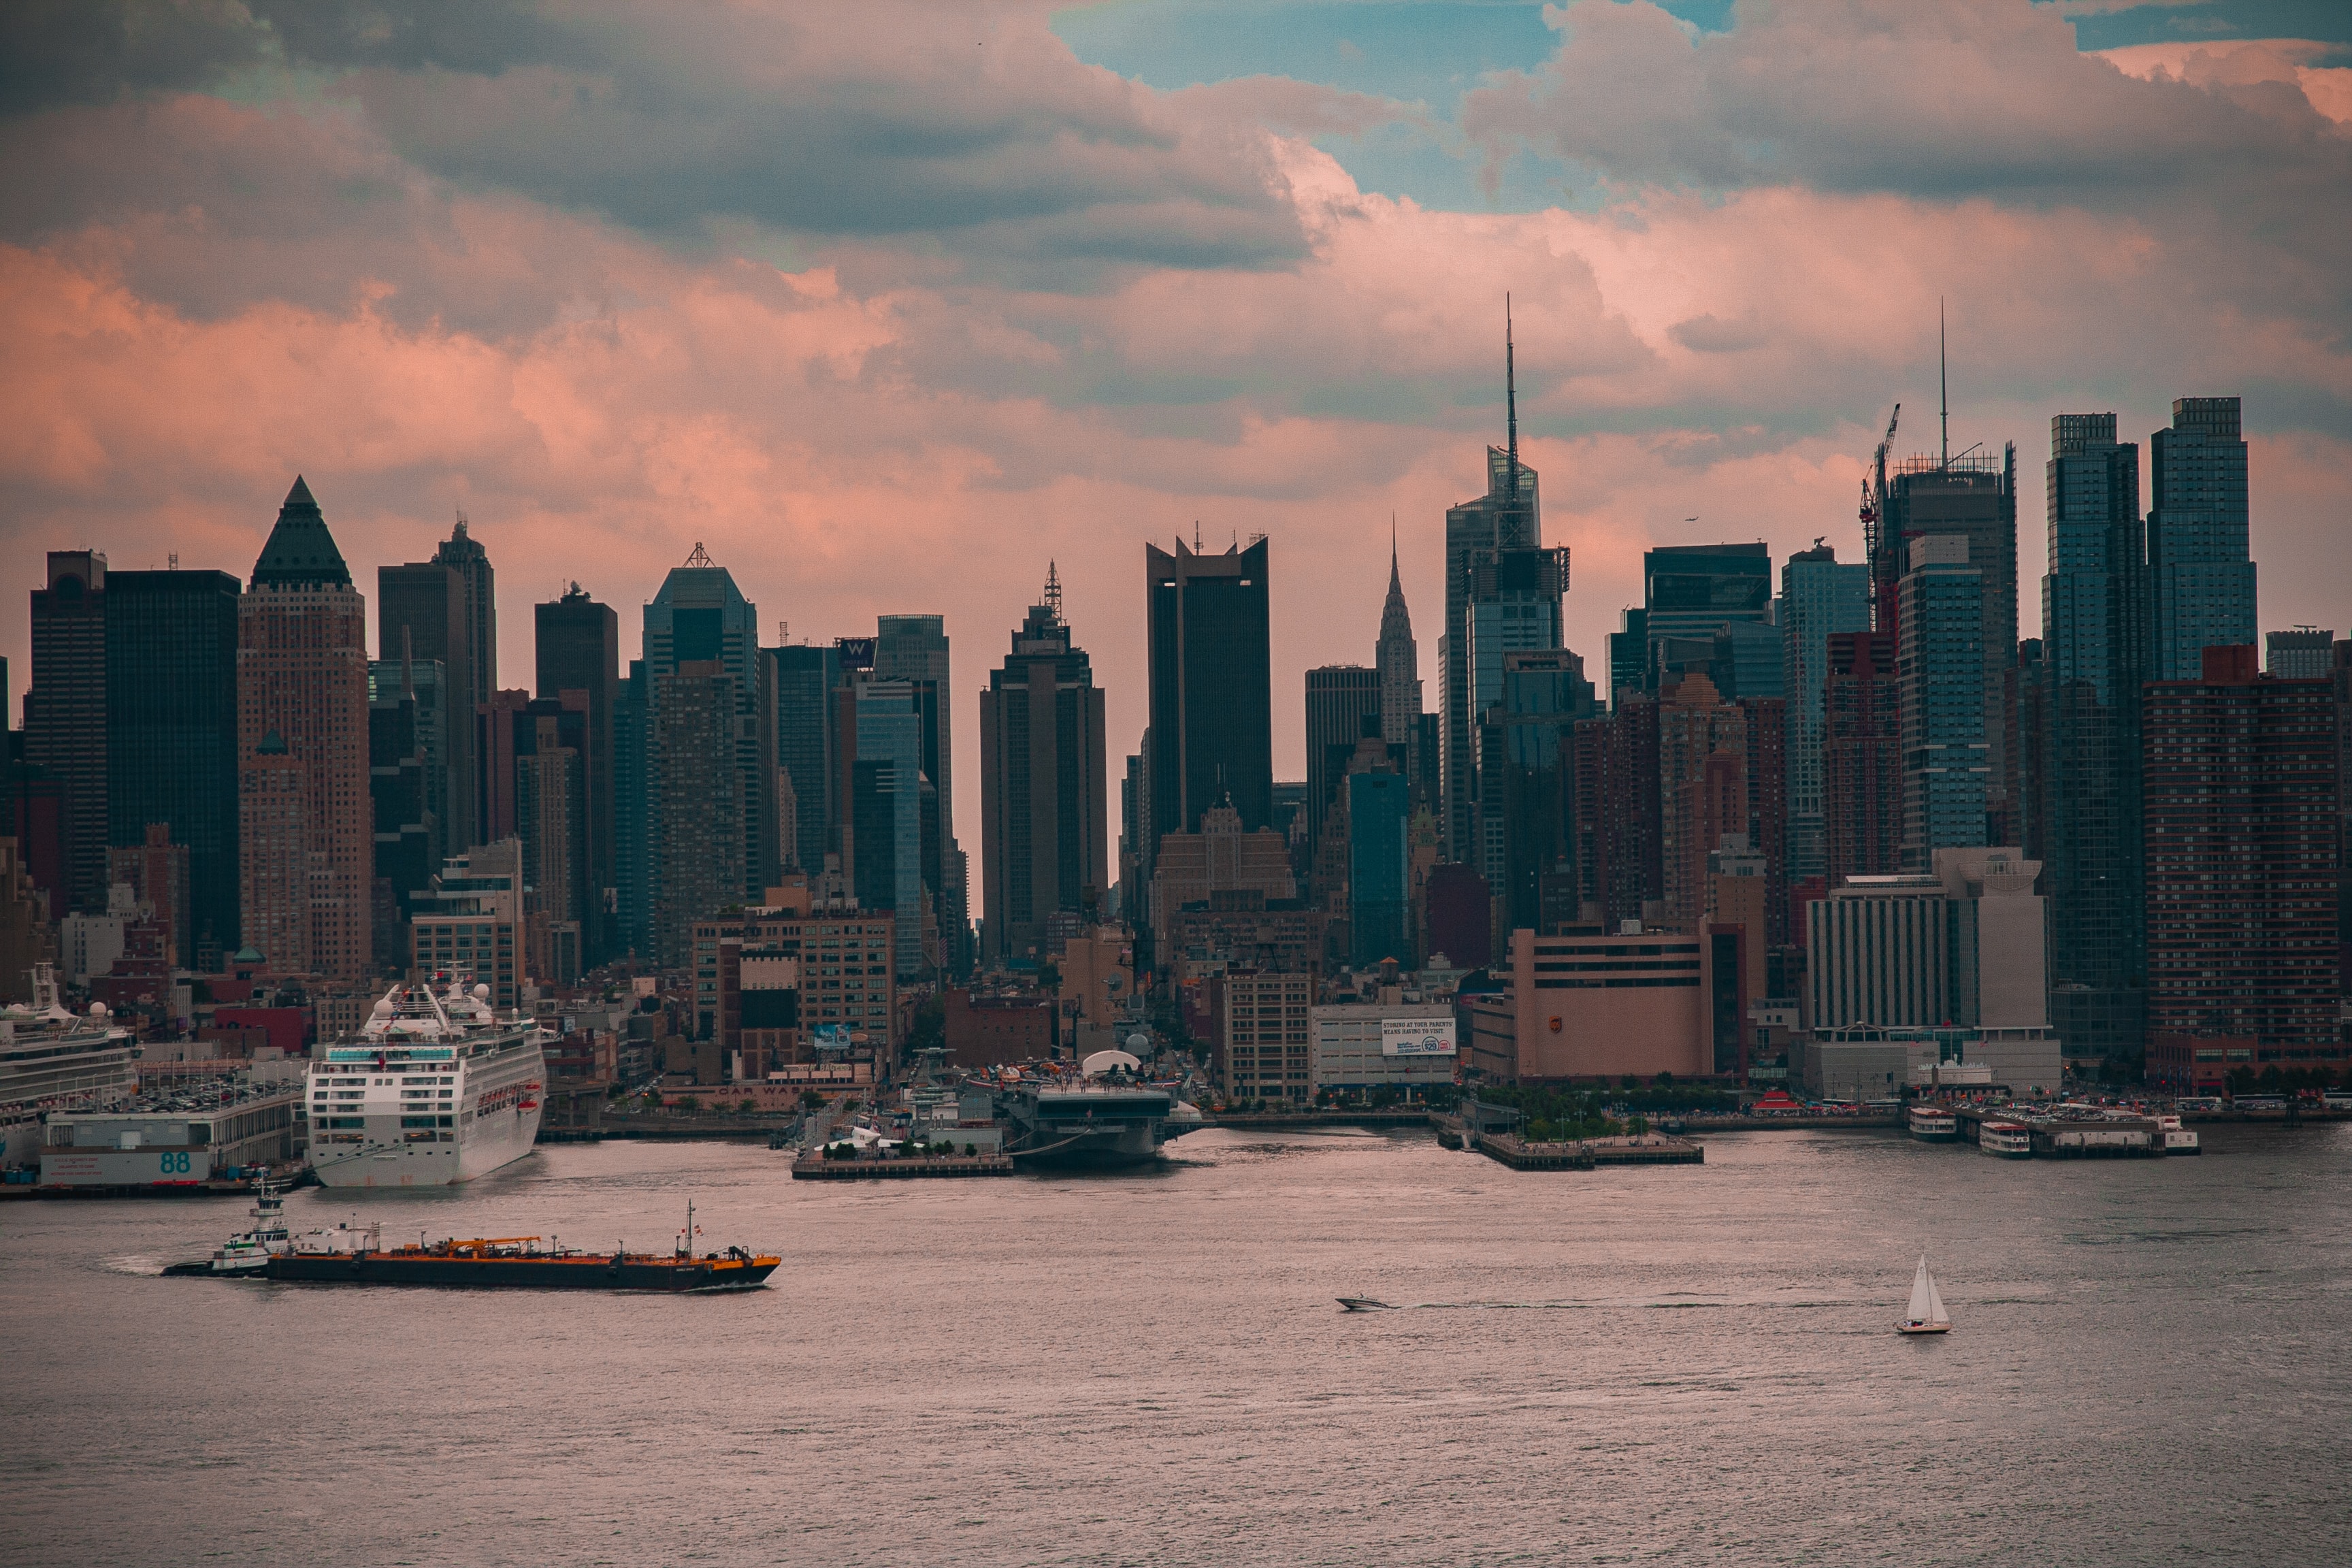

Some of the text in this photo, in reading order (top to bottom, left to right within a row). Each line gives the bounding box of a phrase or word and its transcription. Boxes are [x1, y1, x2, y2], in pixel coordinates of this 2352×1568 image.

[847, 642, 865, 655] W
[1424, 1043, 1437, 1051] $29
[820, 1063, 850, 1072] BAGELS
[763, 1086, 813, 1095] WASH
[161, 1152, 191, 1174] 88
[230, 1240, 238, 1250] V
